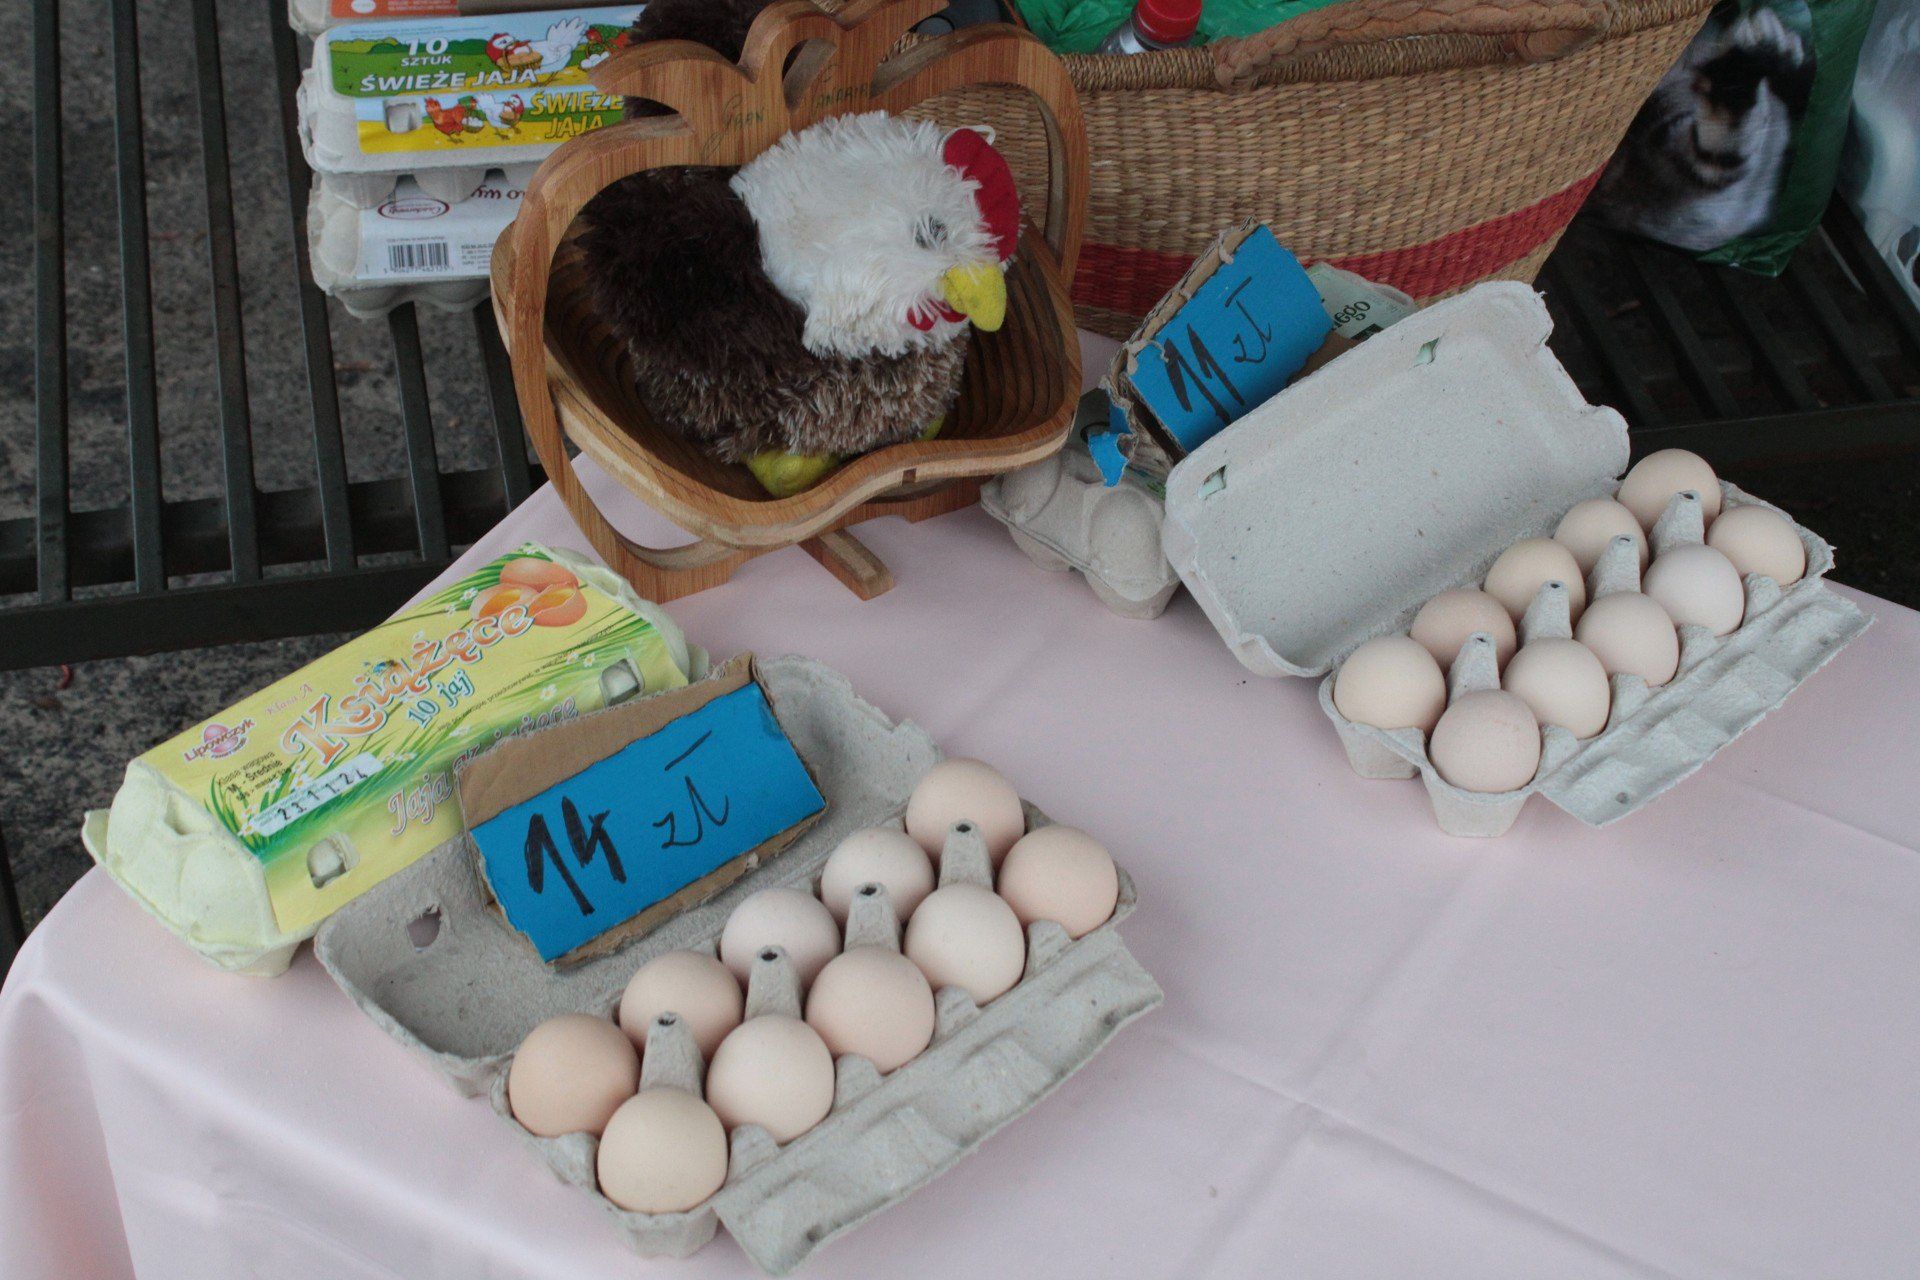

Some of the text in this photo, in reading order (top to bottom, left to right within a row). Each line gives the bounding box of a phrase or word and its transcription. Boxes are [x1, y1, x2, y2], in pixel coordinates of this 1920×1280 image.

[400, 54, 453, 68] SZTUK
[407, 37, 449, 56] 10
[360, 67, 537, 93] ŚWIEŻE JAJA
[544, 114, 603, 139] JAJA
[281, 603, 534, 767] Książęce
[406, 697, 440, 730] 10
[437, 668, 476, 709] jaj
[183, 717, 256, 763] Lipowczyk
[387, 772, 454, 837] Jaja
